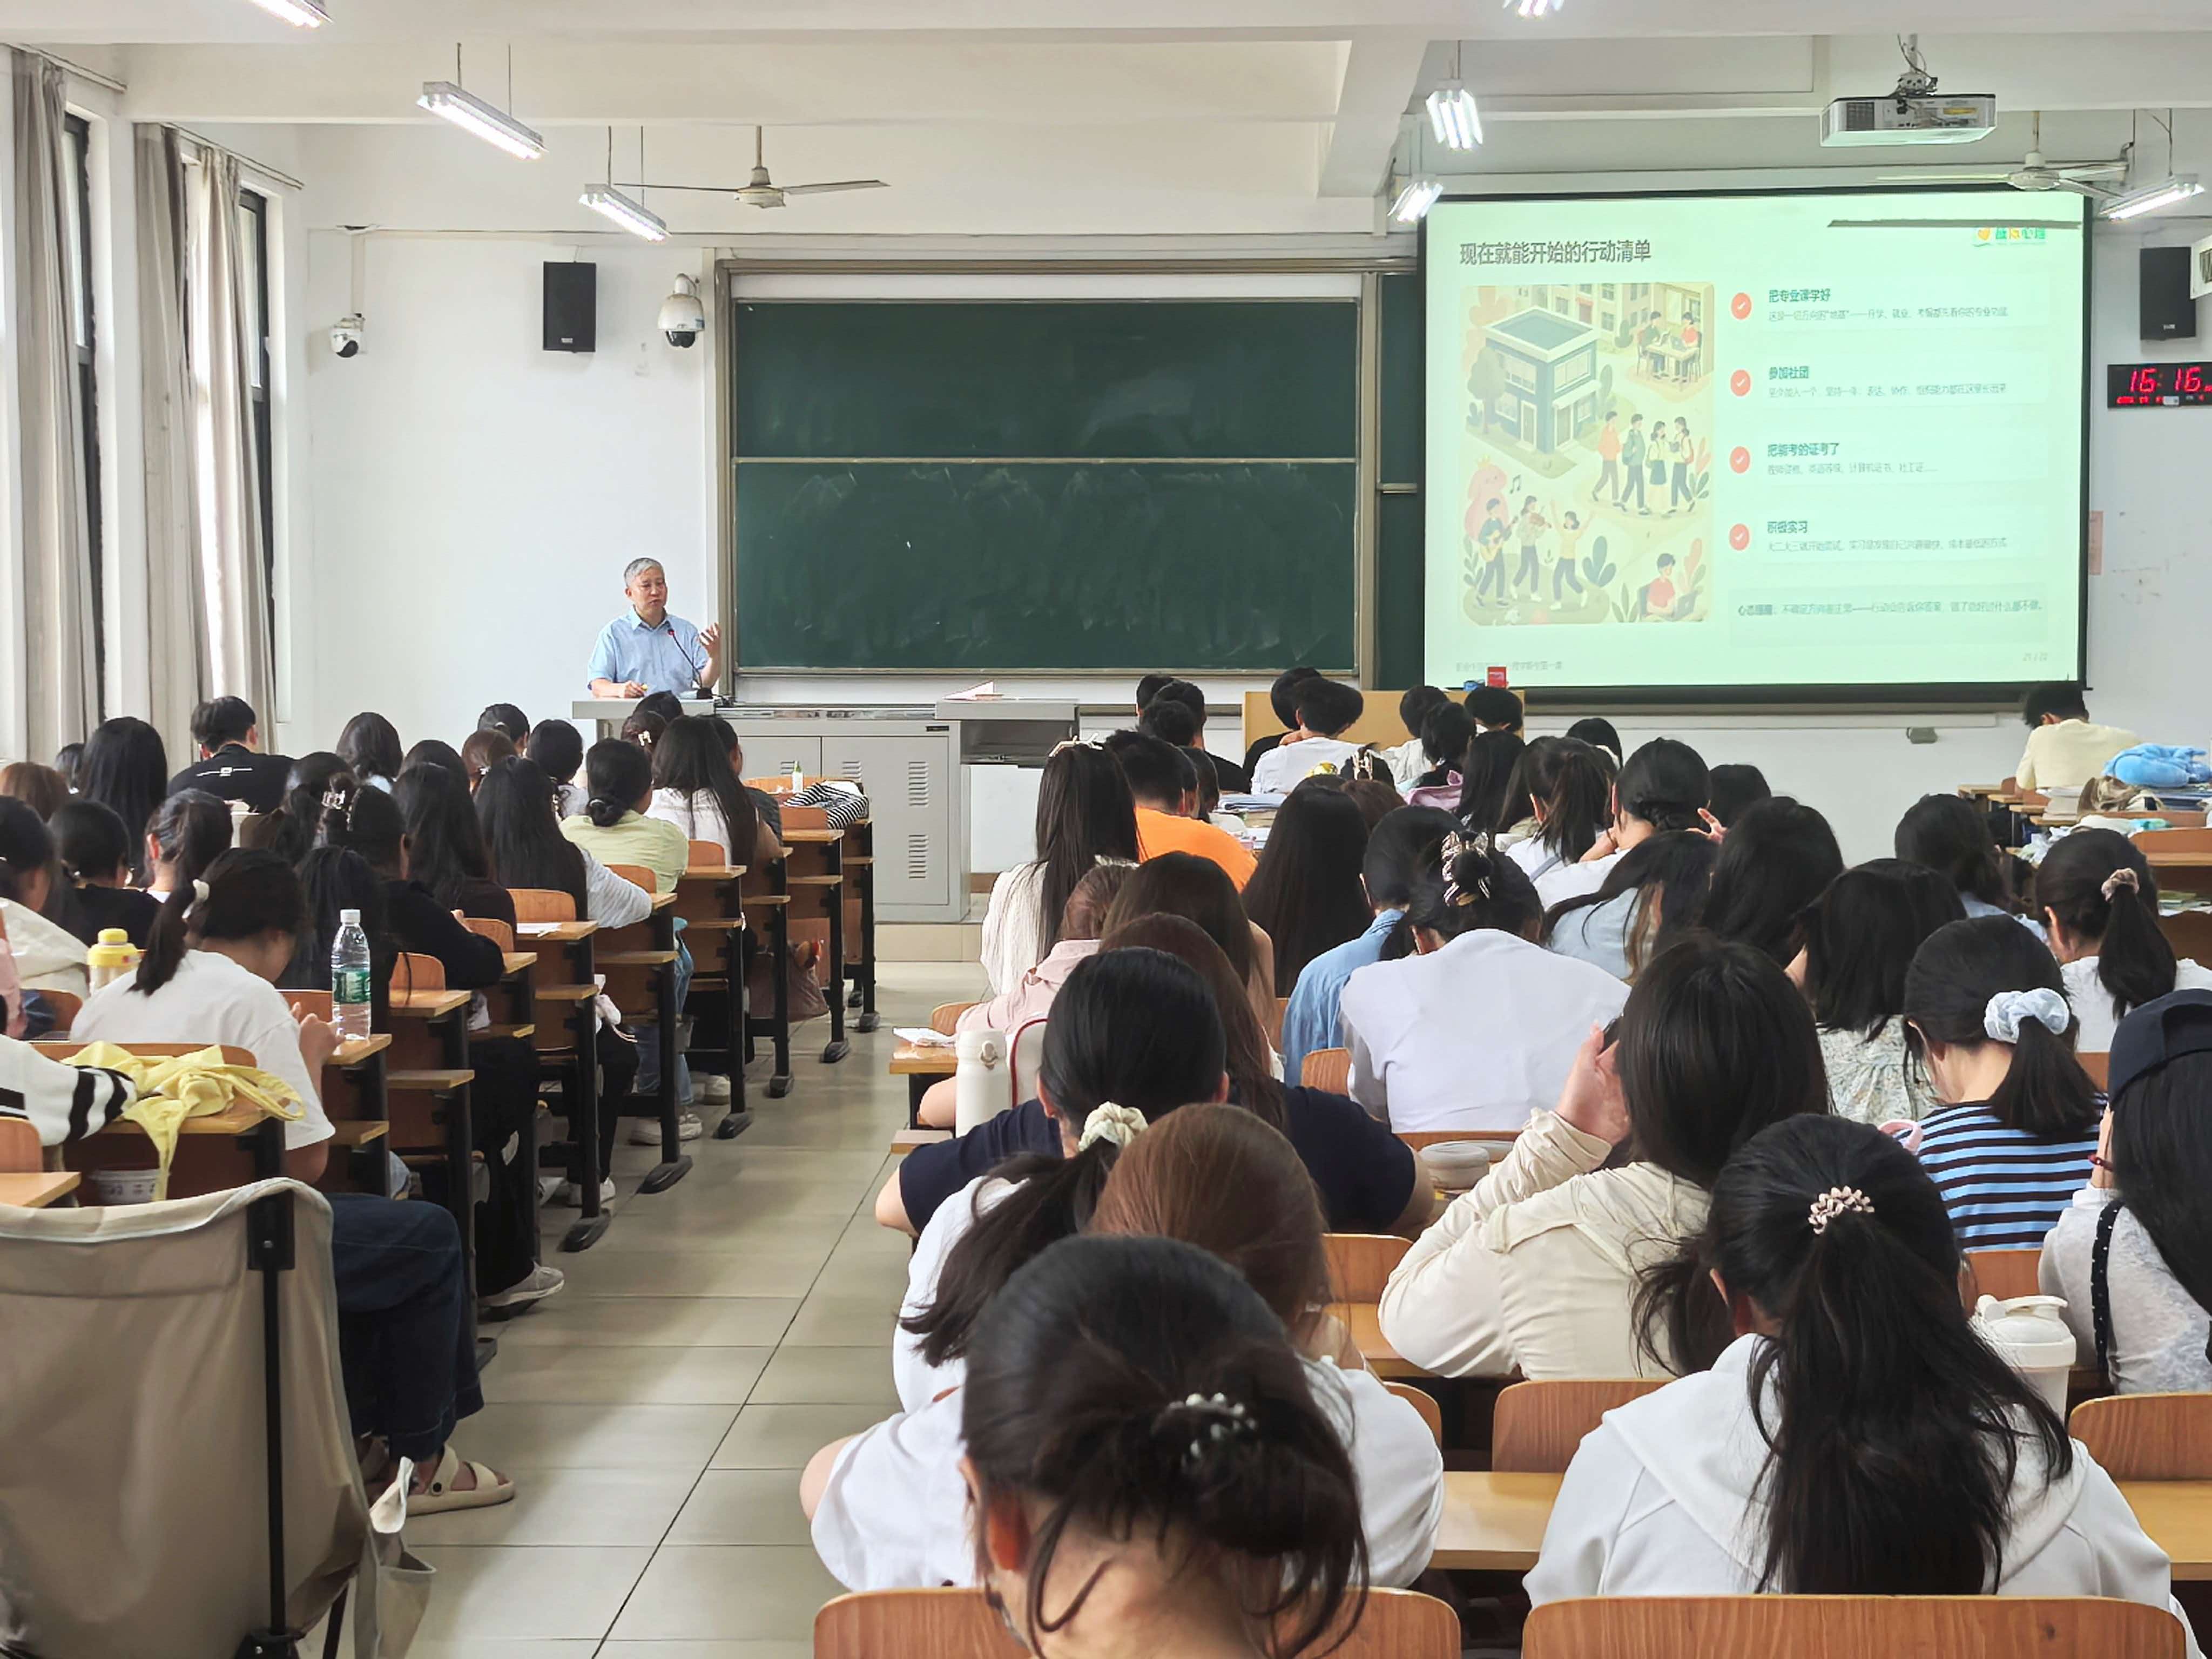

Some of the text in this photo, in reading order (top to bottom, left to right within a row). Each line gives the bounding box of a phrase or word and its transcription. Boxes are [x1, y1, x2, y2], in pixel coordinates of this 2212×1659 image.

[1460, 240, 1651, 265] 现在就能开始的行动清单
[1769, 288, 1831, 302] 把专业课学好
[1769, 366, 1809, 380] 参加社团
[1767, 521, 1808, 534] 积极实习
